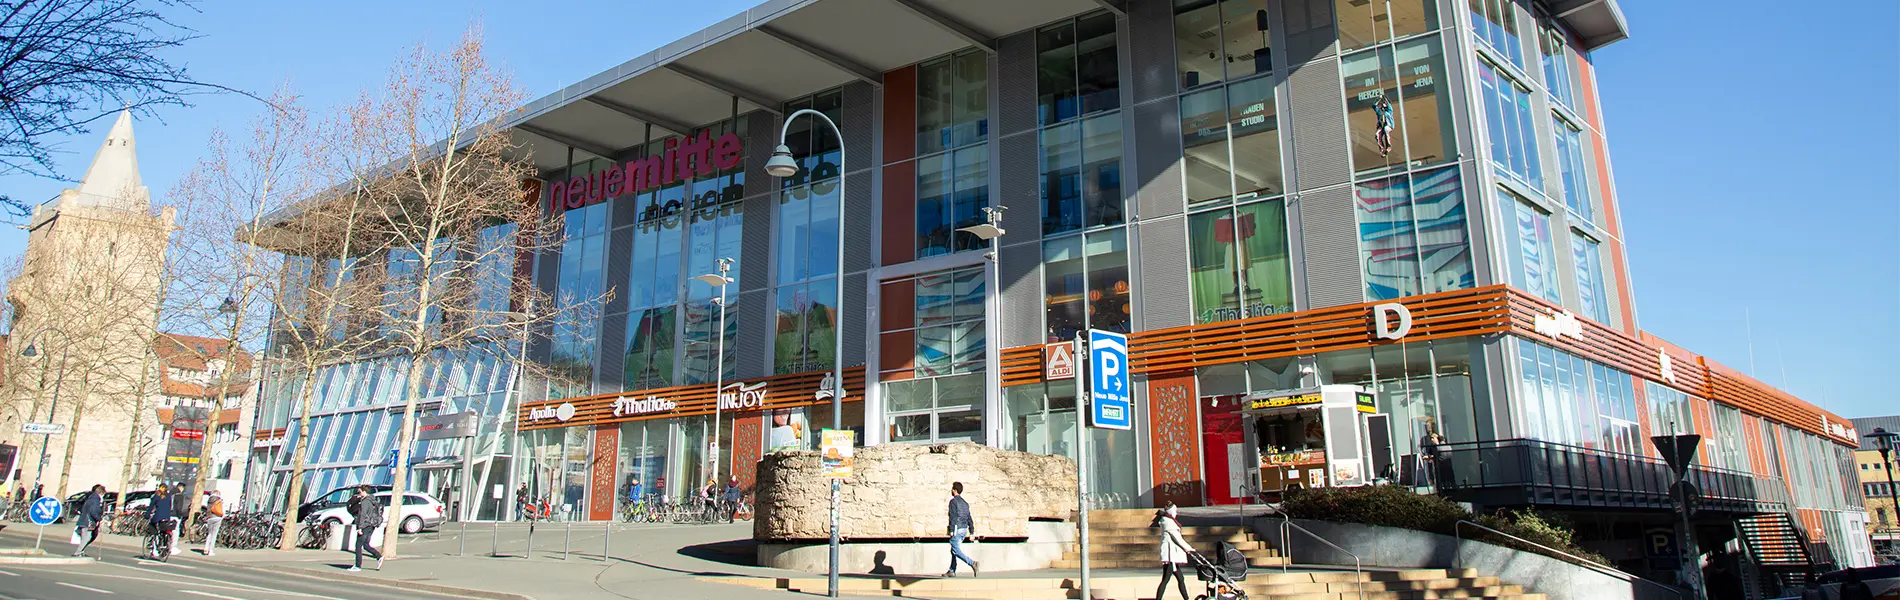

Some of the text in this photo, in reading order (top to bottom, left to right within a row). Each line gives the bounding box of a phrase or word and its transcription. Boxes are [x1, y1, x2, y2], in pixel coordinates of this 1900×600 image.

[1414, 64, 1430, 75] VON
[1364, 77, 1375, 87] IM
[1414, 76, 1433, 88] JENA
[1358, 88, 1385, 101] HERZEN
[1241, 114, 1264, 127] STUDIO
[1101, 351, 1119, 389] P
[720, 390, 767, 410] INJOY
[529, 407, 556, 422] Apollo
